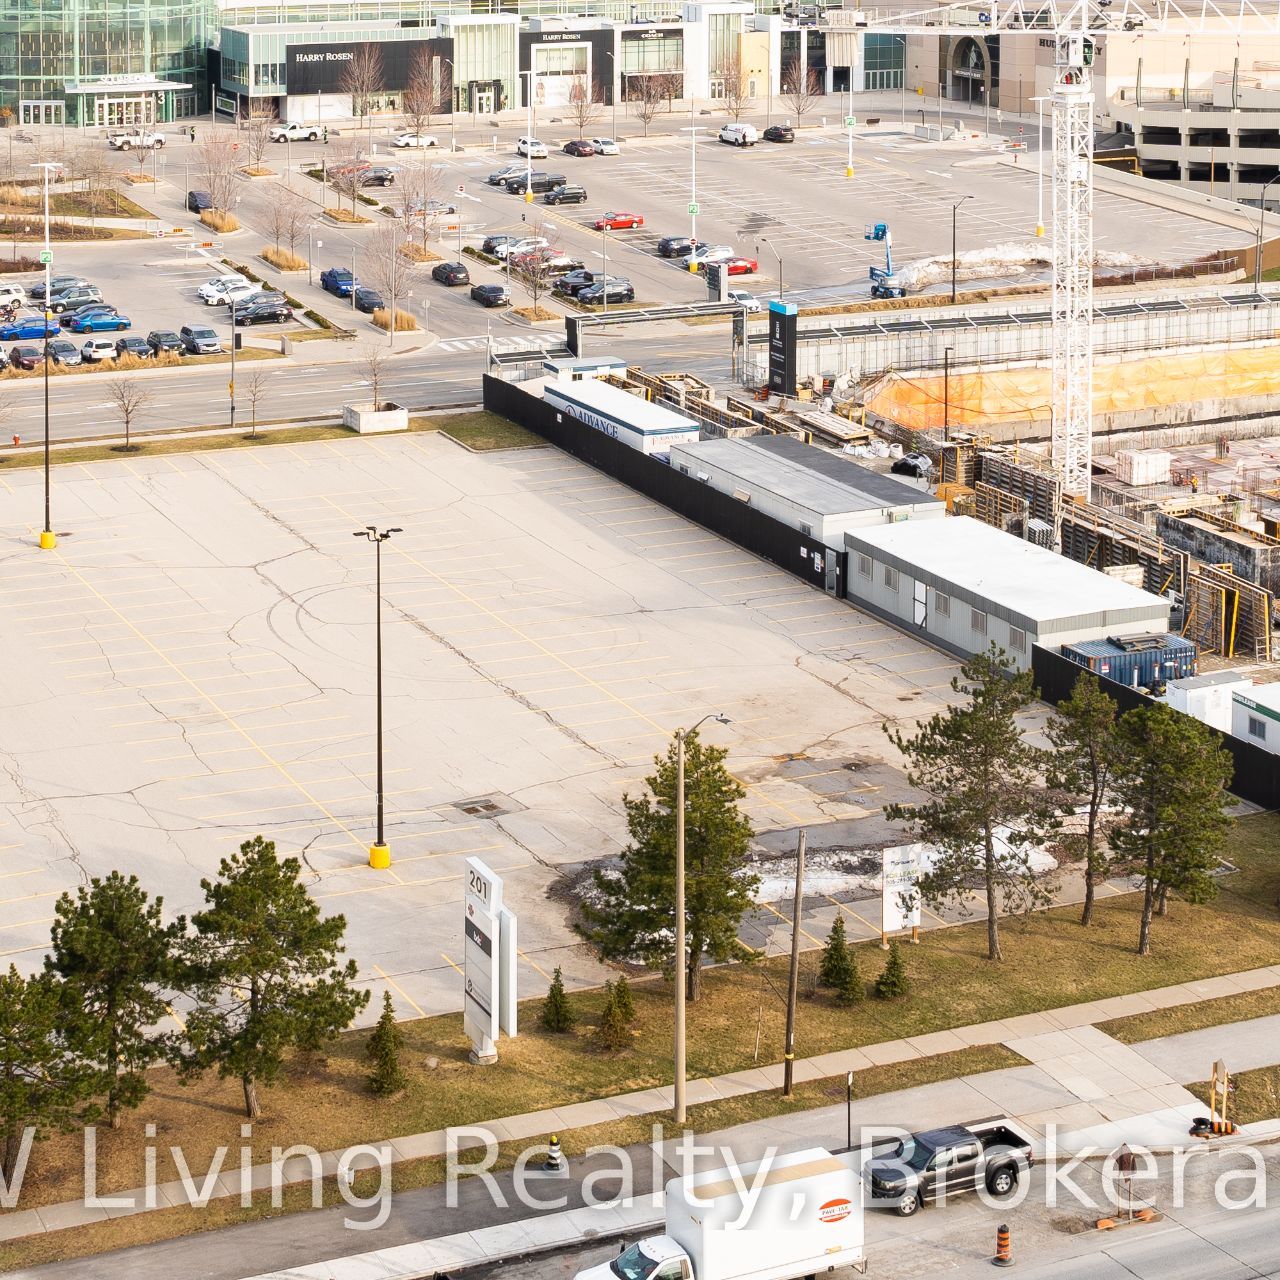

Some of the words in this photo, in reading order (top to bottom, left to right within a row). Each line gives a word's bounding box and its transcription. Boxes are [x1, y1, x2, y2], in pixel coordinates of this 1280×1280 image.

[295, 53, 325, 62] HARRY
[325, 52, 354, 61] ROSEN
[157, 91, 166, 105] 3
[1076, 170, 1082, 179] 2
[578, 409, 619, 439] ADVANCE
[469, 870, 488, 900] 201
